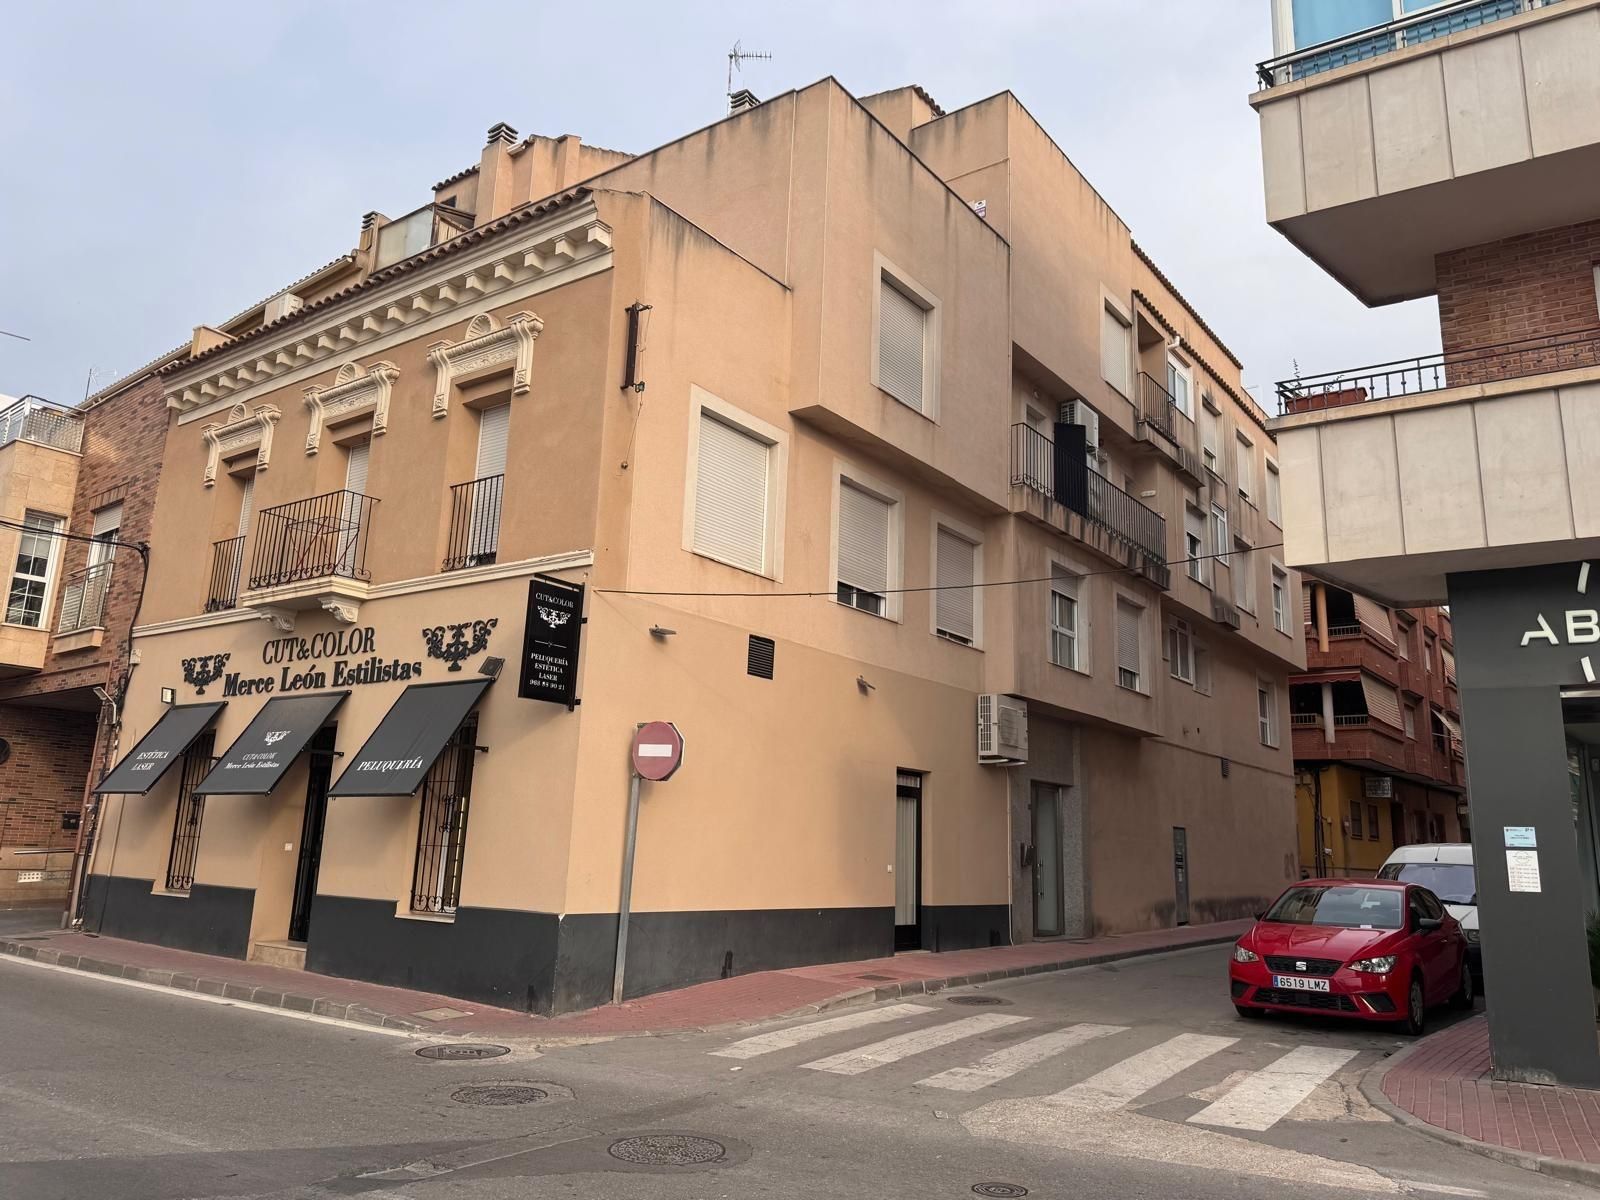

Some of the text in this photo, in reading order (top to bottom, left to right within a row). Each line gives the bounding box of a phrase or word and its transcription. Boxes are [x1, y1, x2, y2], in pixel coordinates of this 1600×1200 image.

[262, 627, 376, 665] CUT&COLOR
[530, 652, 568, 666] PELUQUERÍA
[534, 662, 563, 674] ESTÉTICA
[223, 656, 422, 697] Merce León Estilistas
[538, 672, 558, 681] LASER
[357, 756, 423, 773] PELUQUERÍA
[1280, 978, 1327, 990] 6519 LMZ
